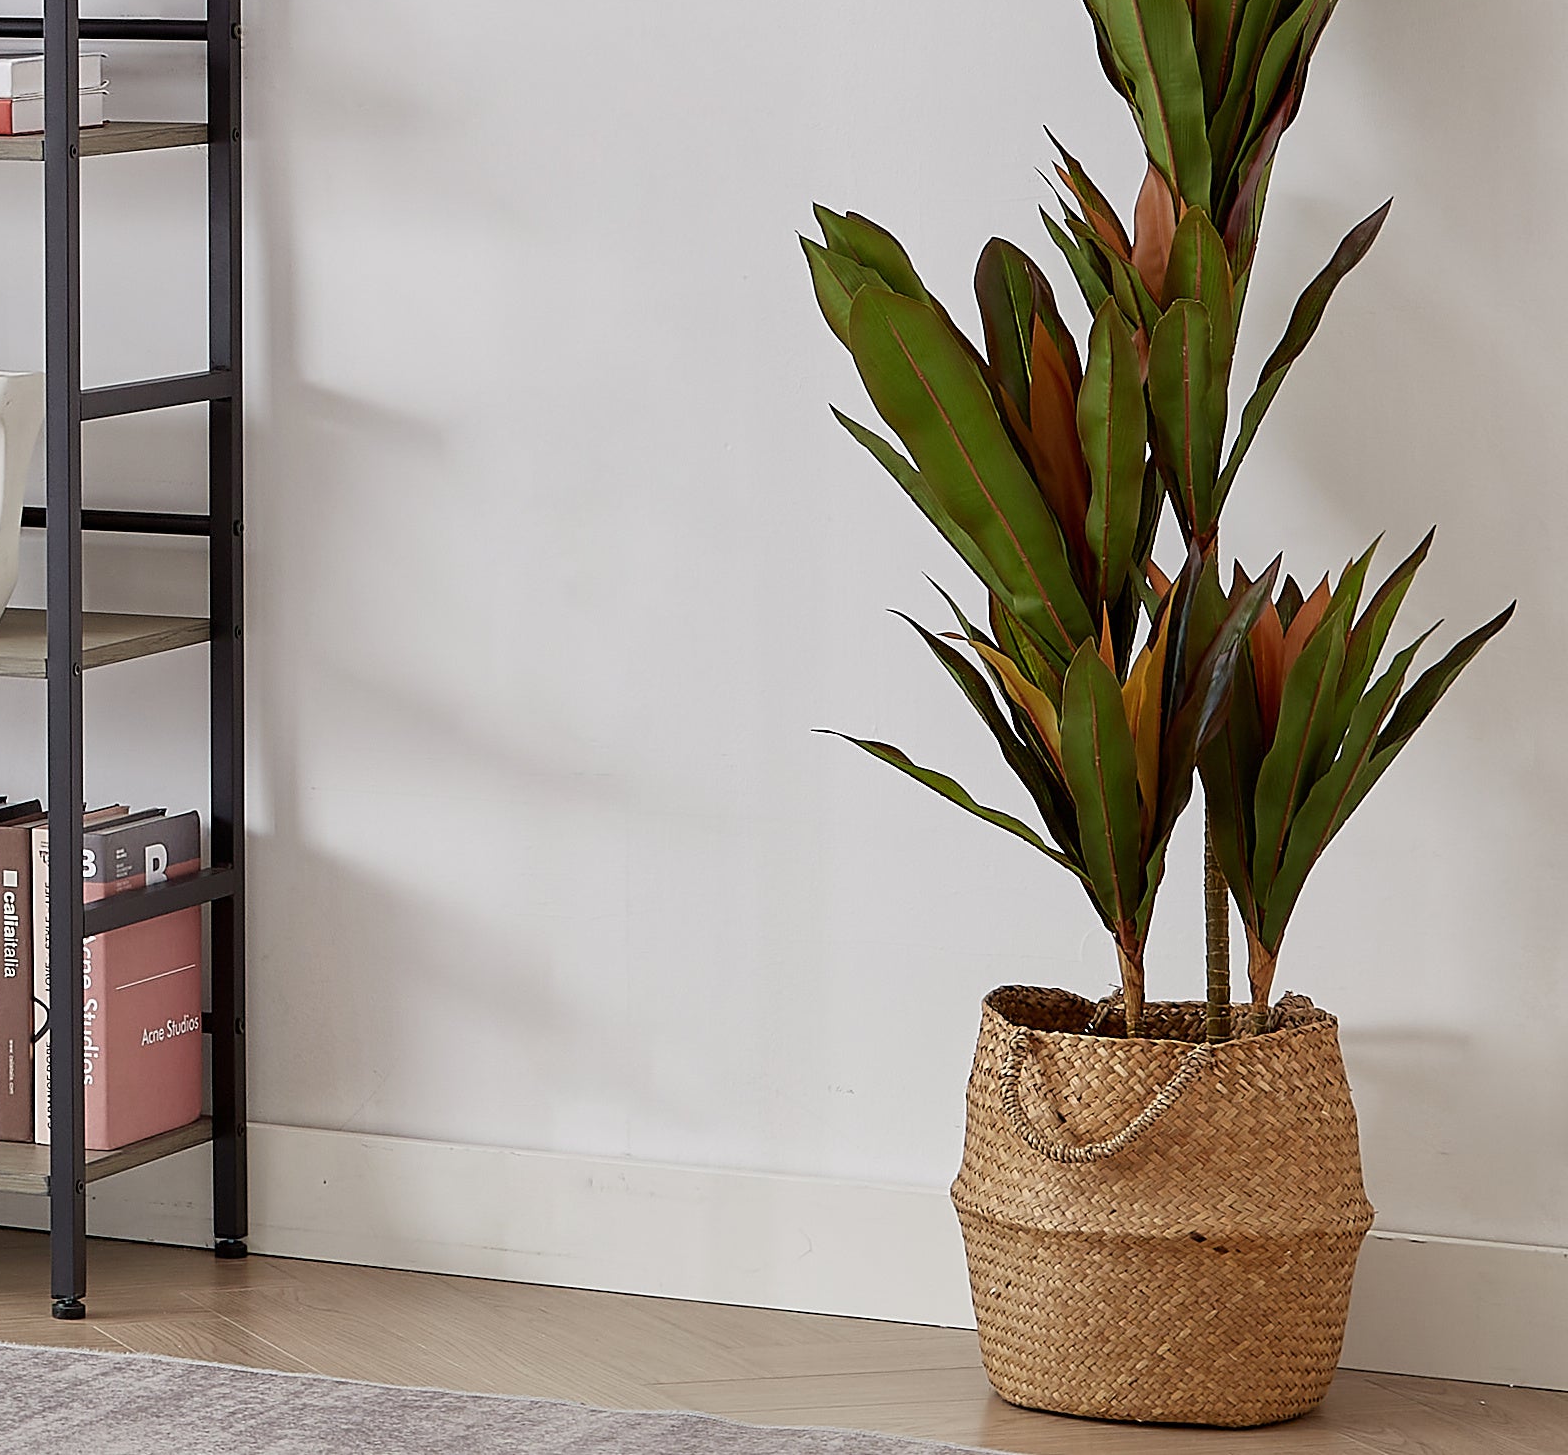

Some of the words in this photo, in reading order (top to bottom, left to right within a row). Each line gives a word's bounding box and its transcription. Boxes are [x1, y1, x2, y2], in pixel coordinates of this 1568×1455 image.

[3, 891, 19, 977] caliaitalia
[141, 1027, 165, 1046] Acne
[166, 1014, 200, 1039] Studios
